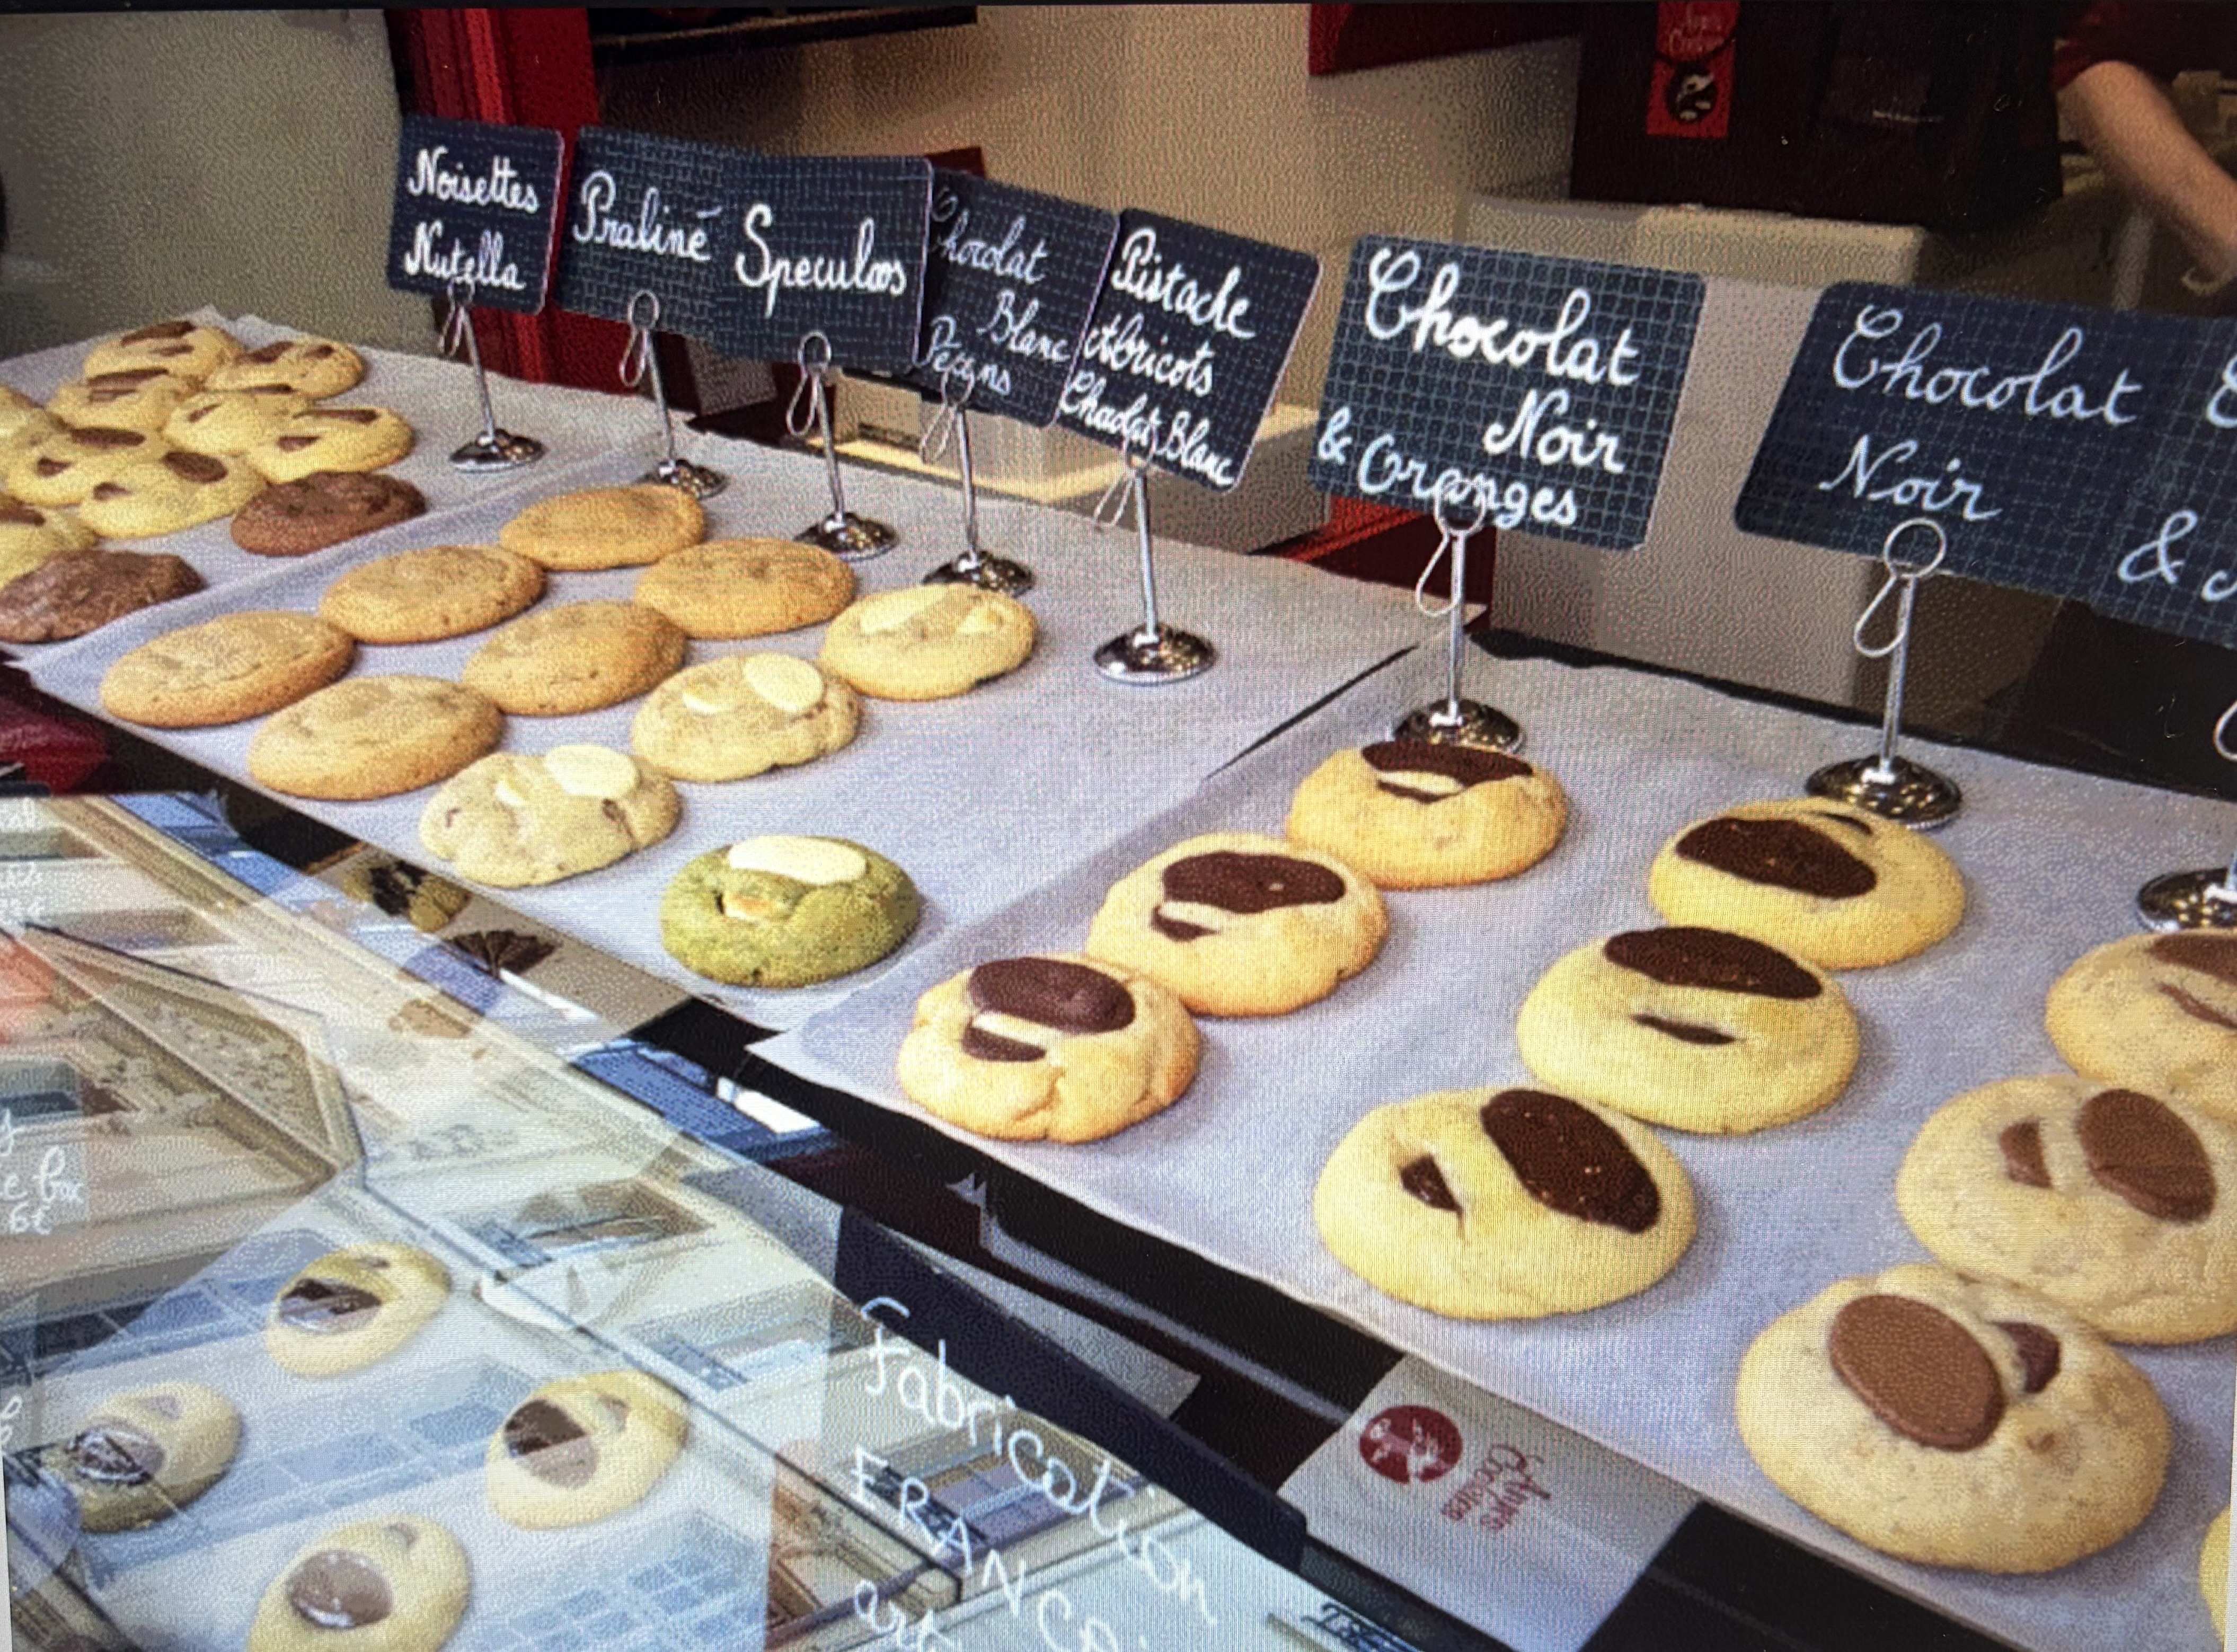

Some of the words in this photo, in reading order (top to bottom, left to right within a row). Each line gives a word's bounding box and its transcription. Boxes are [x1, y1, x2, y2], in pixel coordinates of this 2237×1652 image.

[406, 145, 539, 214] Noisettes
[573, 170, 722, 262] Praliné
[403, 220, 527, 290] Nutella
[1111, 227, 1257, 338] Pistache
[976, 290, 1071, 363] Blanc
[1365, 247, 1641, 387] Chocolat
[1833, 303, 2143, 426] Chocolat
[1317, 406, 1352, 465] &
[1358, 432, 1578, 531] Oranges
[1483, 388, 1626, 474] Noir
[1818, 432, 2003, 522] Noir
[2117, 509, 2198, 586] &
